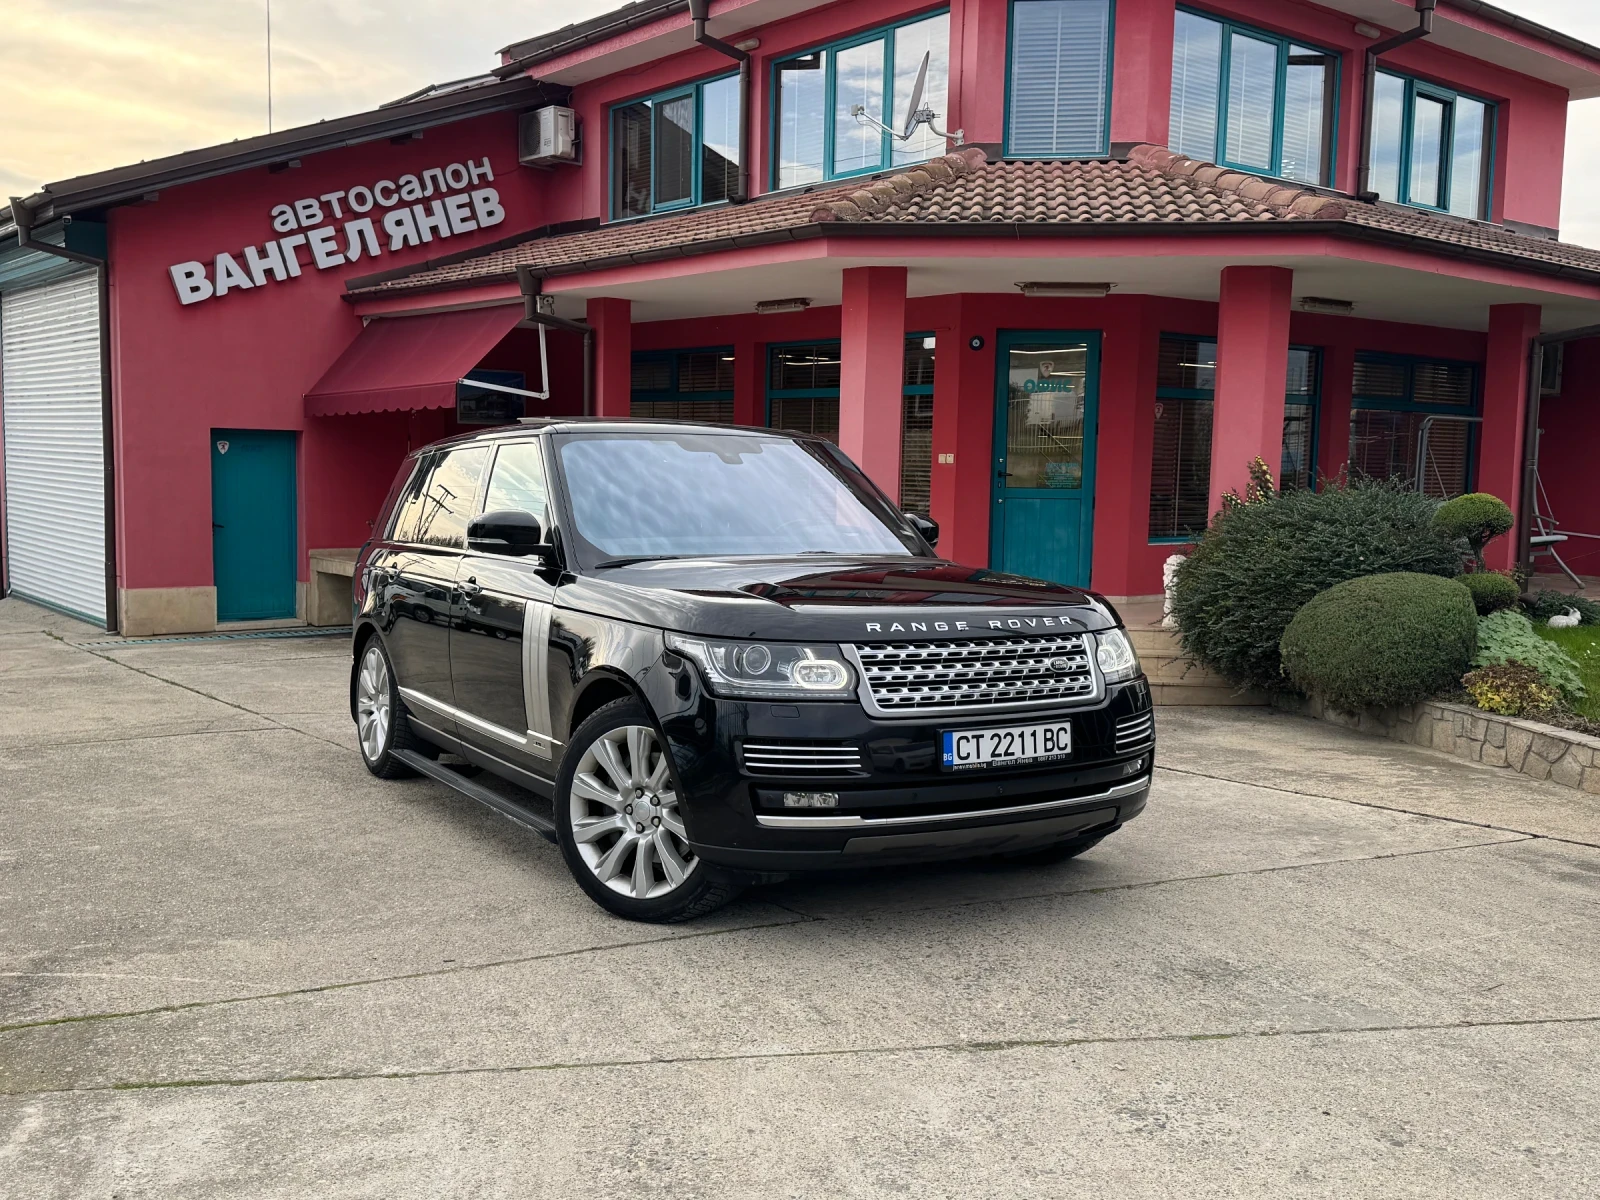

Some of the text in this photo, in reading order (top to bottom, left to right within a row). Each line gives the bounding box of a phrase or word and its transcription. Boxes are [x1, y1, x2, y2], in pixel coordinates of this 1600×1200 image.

[269, 156, 495, 233] автосалон
[168, 187, 506, 306] ВАНГЕЛ ЯНЕВ
[865, 616, 1073, 633] RANGE ROVER
[943, 753, 953, 761] BG
[956, 726, 1069, 761] CT 2211 BC
